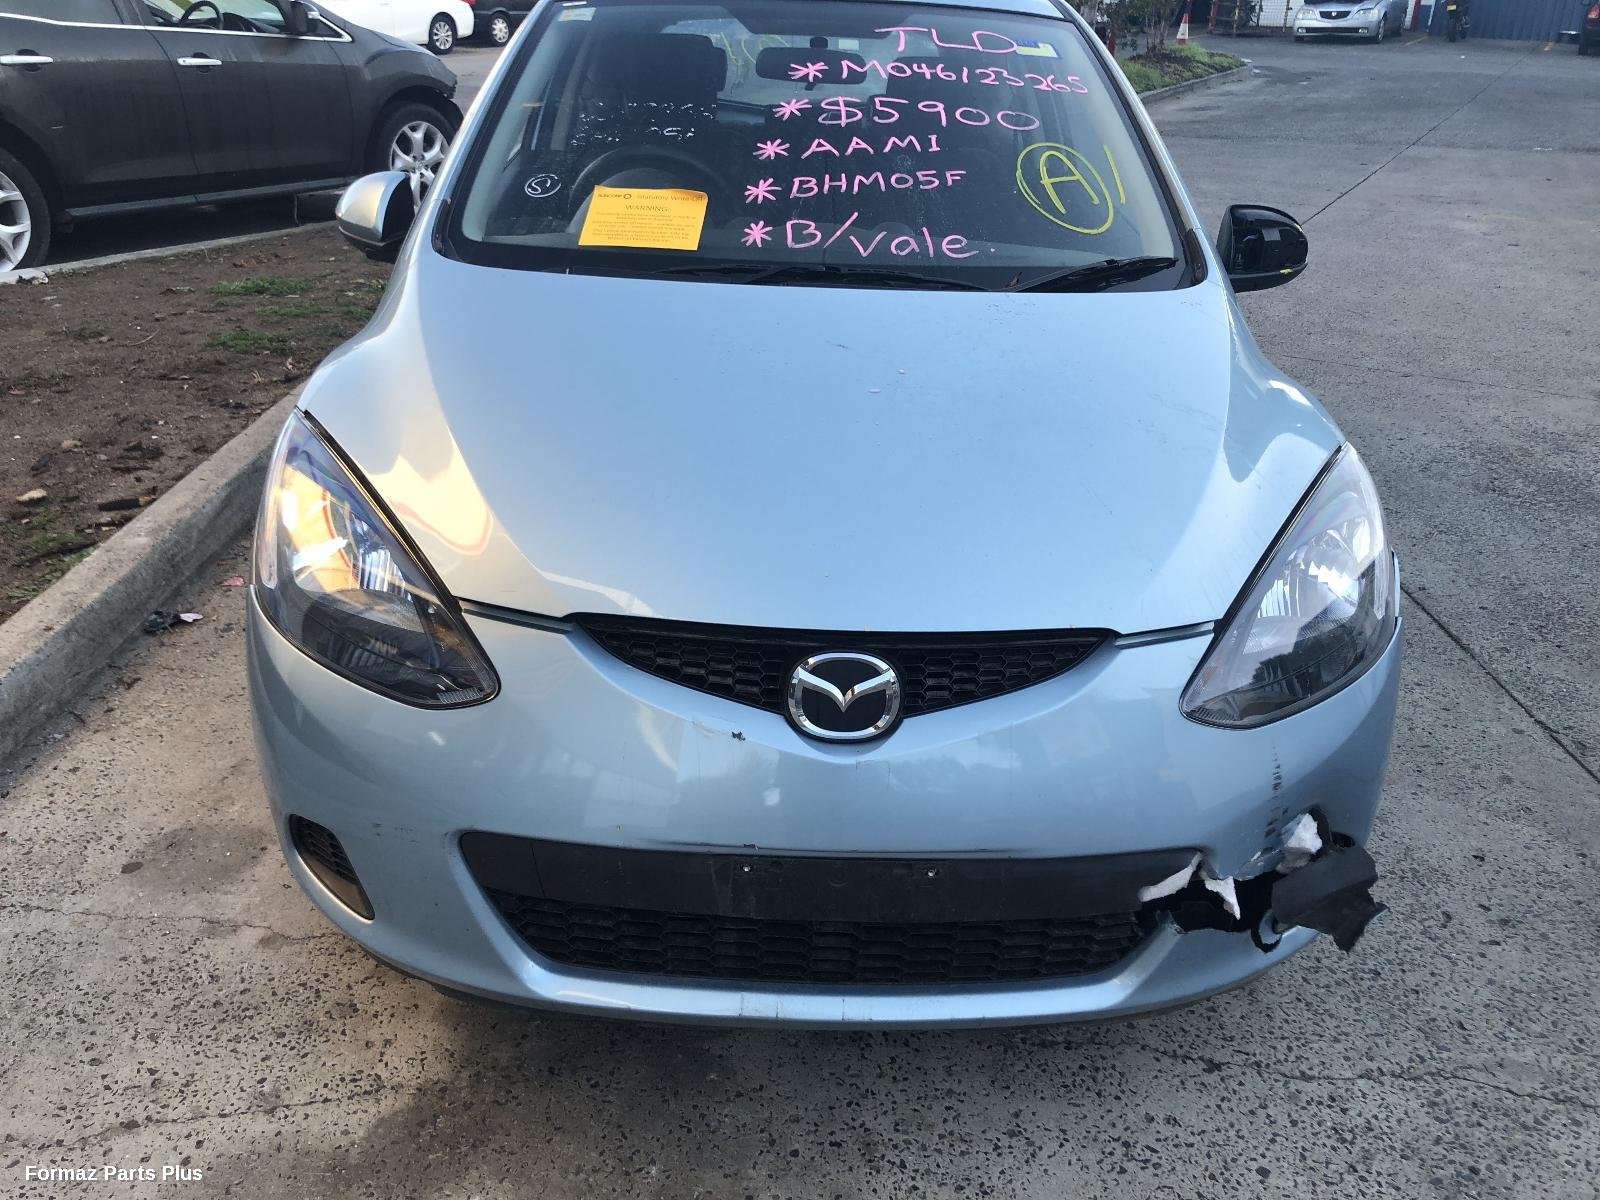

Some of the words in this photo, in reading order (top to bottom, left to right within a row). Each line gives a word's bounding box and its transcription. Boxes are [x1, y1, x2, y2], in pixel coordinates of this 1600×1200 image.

[875, 27, 1019, 54] TLD
[841, 59, 1088, 95] M046123265
[818, 96, 1040, 131] $5900
[801, 135, 940, 159] AAMI
[790, 170, 967, 198] BHM05F
